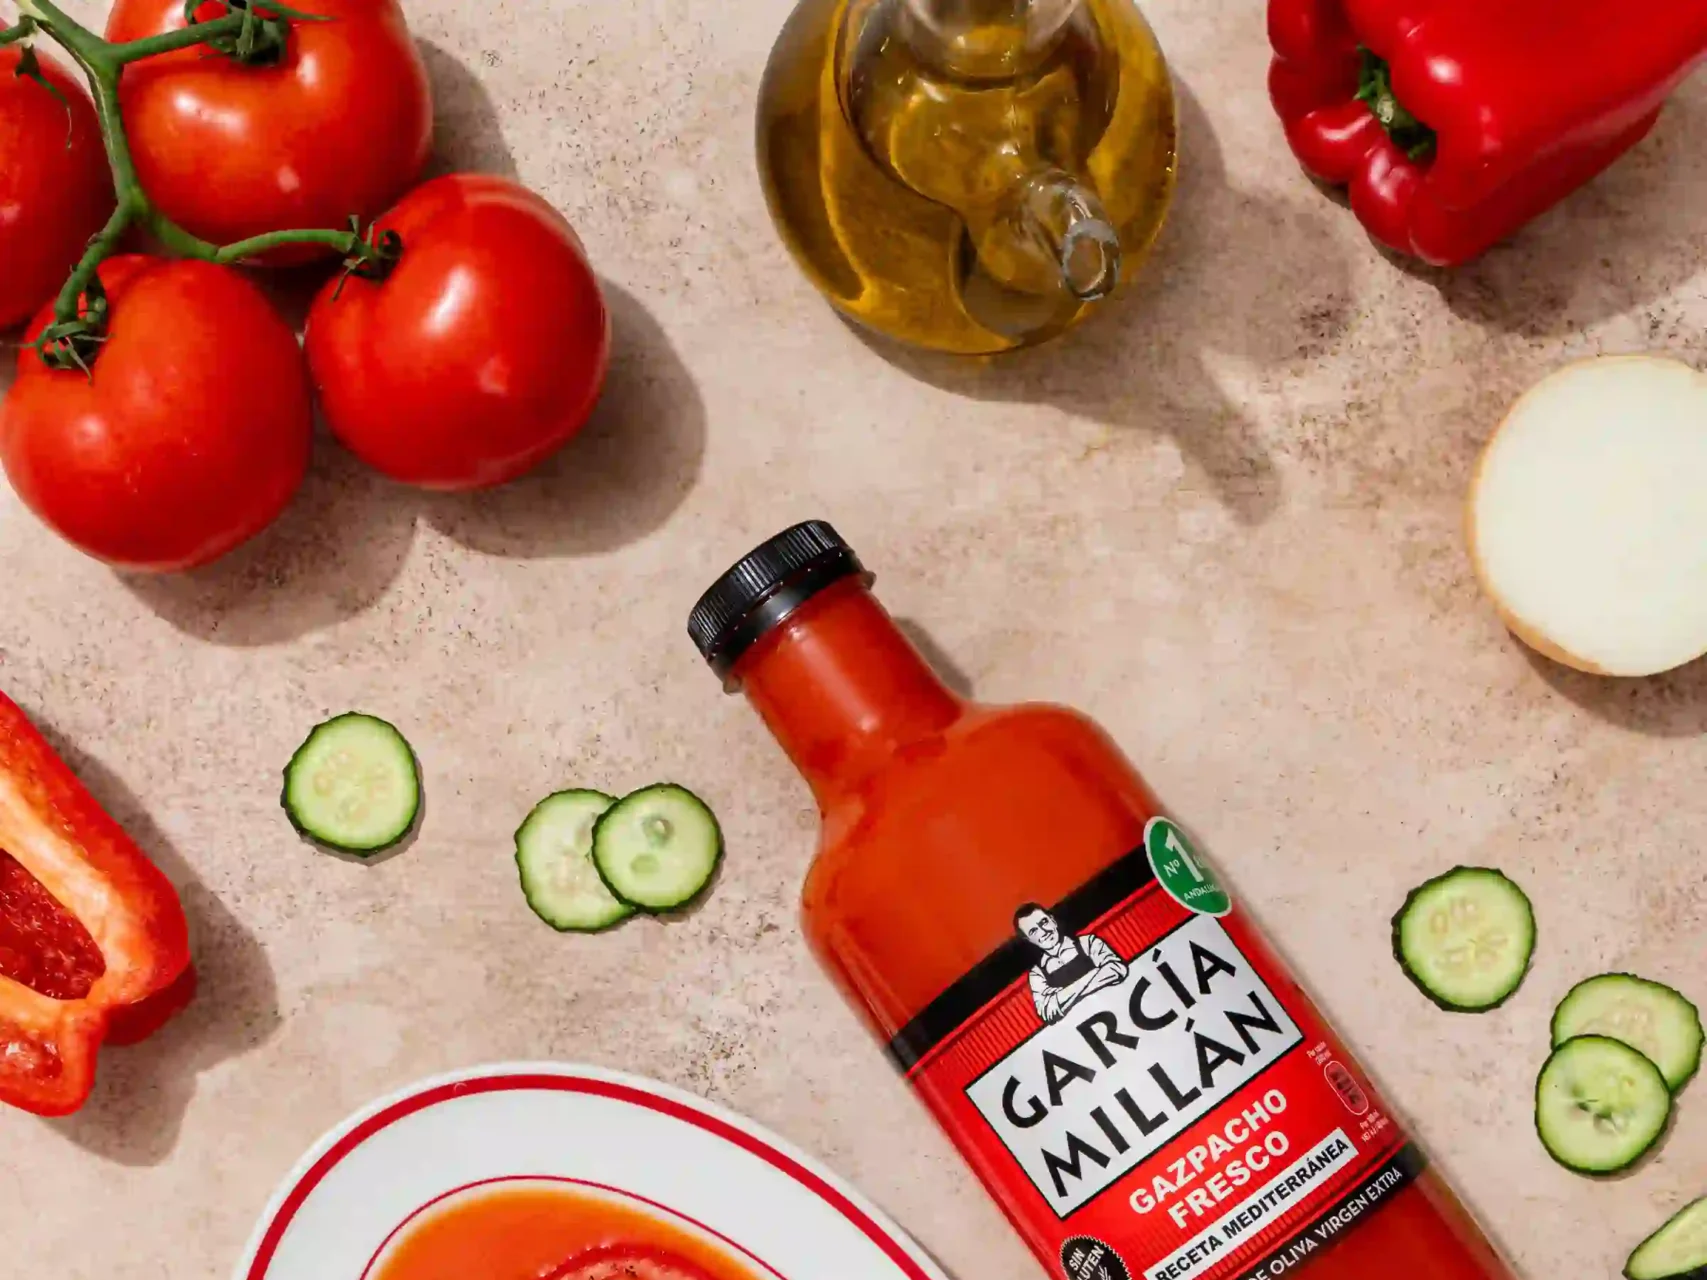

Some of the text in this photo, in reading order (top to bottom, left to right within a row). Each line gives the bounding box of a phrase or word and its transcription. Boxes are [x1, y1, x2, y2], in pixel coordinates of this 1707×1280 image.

[1164, 827, 1205, 883] 1
[1002, 940, 1236, 1128] GARCÍA
[1041, 991, 1283, 1198] MILLÁN
[1129, 1089, 1287, 1214] GAZPACHO
[1167, 1131, 1289, 1229] FRESCO
[1222, 1138, 1350, 1240] MEDITERRÁNEA
[1069, 1247, 1085, 1271] SIN
[1269, 1237, 1318, 1275] OLIVA
[1313, 1194, 1369, 1240] VIRGEN
[1364, 1166, 1403, 1202] EXTRA
